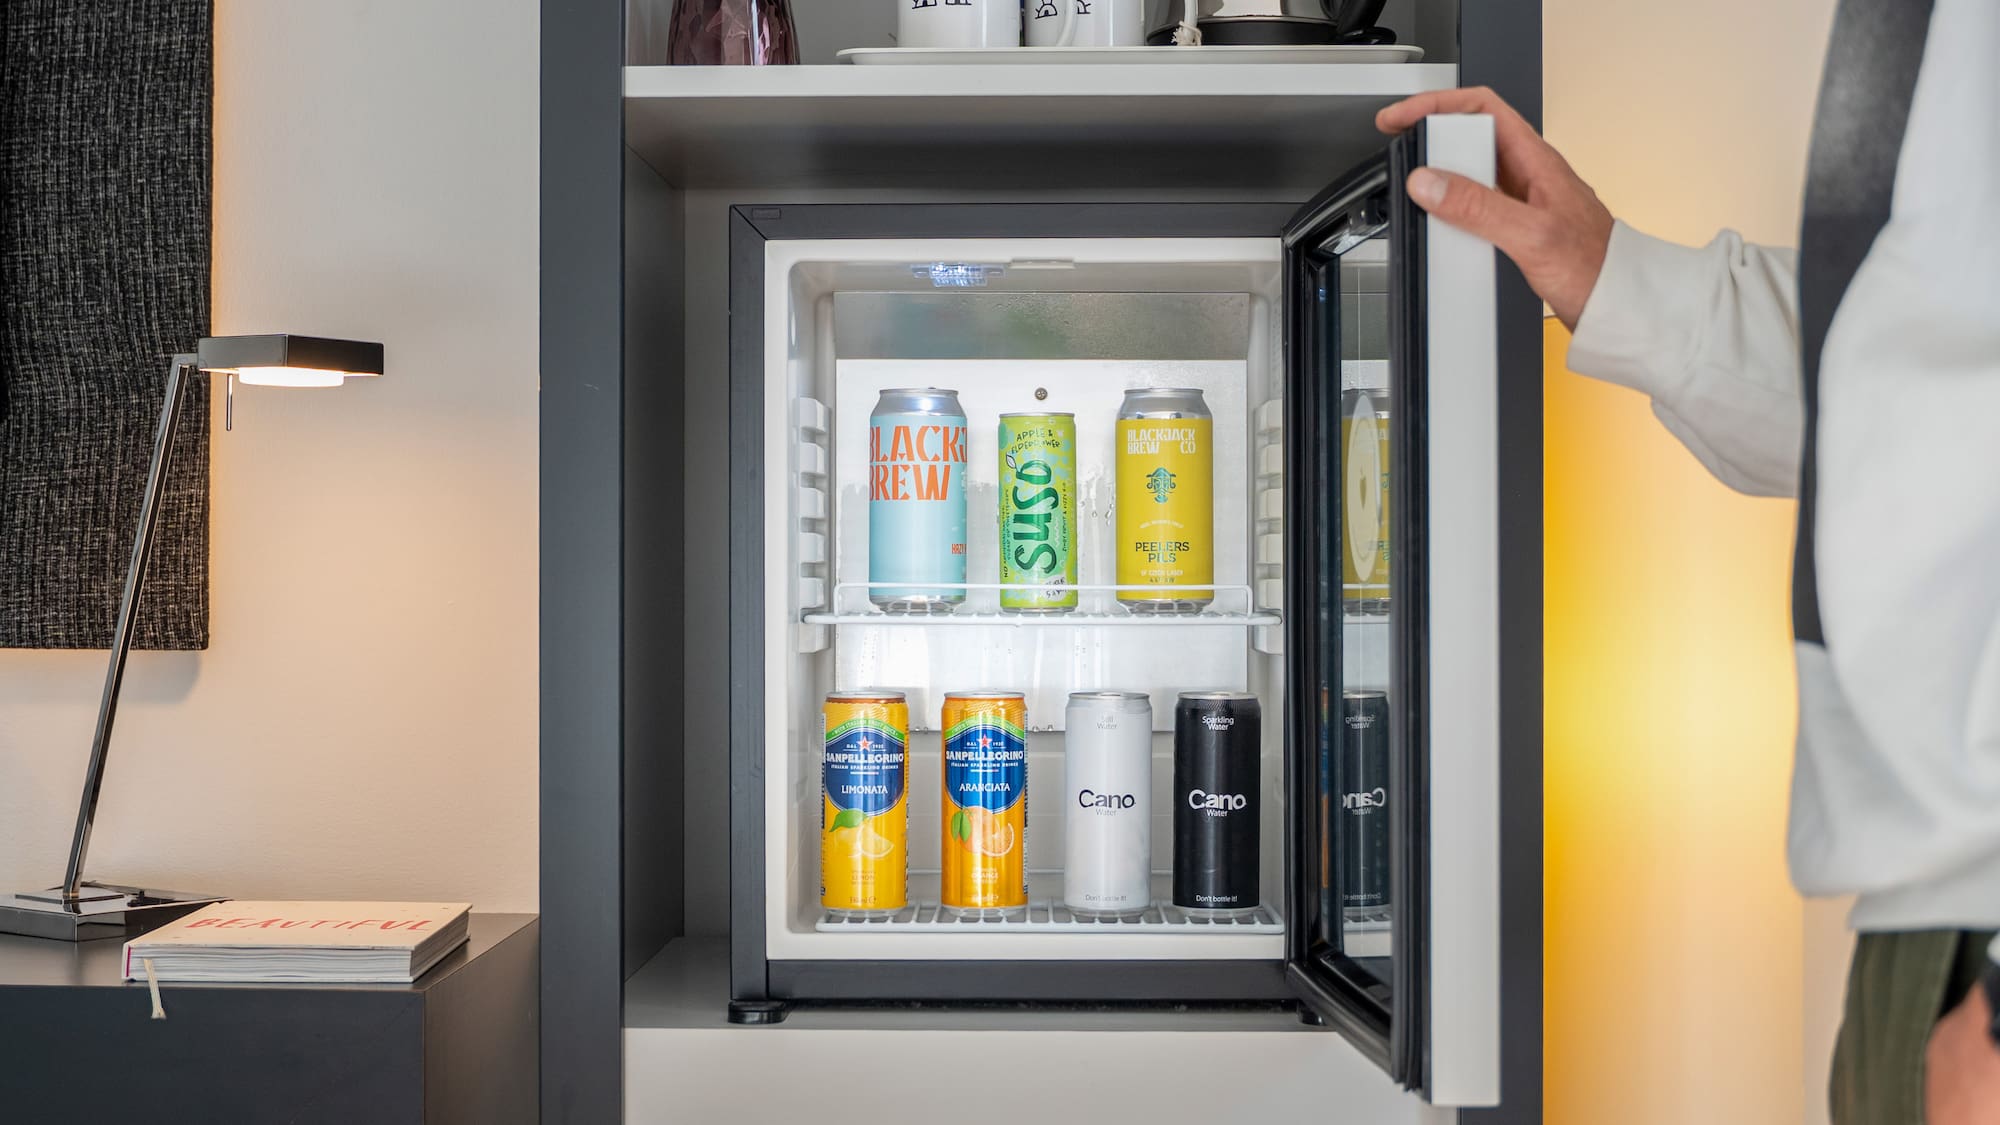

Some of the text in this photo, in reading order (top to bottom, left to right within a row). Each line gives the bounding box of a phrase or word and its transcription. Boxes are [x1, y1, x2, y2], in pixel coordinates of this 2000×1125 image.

[1016, 427, 1046, 441] APPLE
[1127, 428, 1196, 441] BLACKJACK
[1127, 441, 1196, 455] BREW CO
[1135, 541, 1190, 552] PEELERS
[1148, 553, 1177, 563] PILS
[1202, 715, 1234, 726] Sparkling
[826, 753, 904, 763] SANPELLEGRINO
[946, 751, 1024, 761] SANPELLEGRINO
[841, 785, 888, 794] LIMONATA
[959, 783, 1011, 792] ARANCIATA
[1079, 789, 1135, 809] Cano
[1188, 789, 1246, 810] Cano
[1095, 808, 1117, 816] Water
[1206, 809, 1228, 817] Water
[184, 918, 433, 931] BEAUTIFUL
